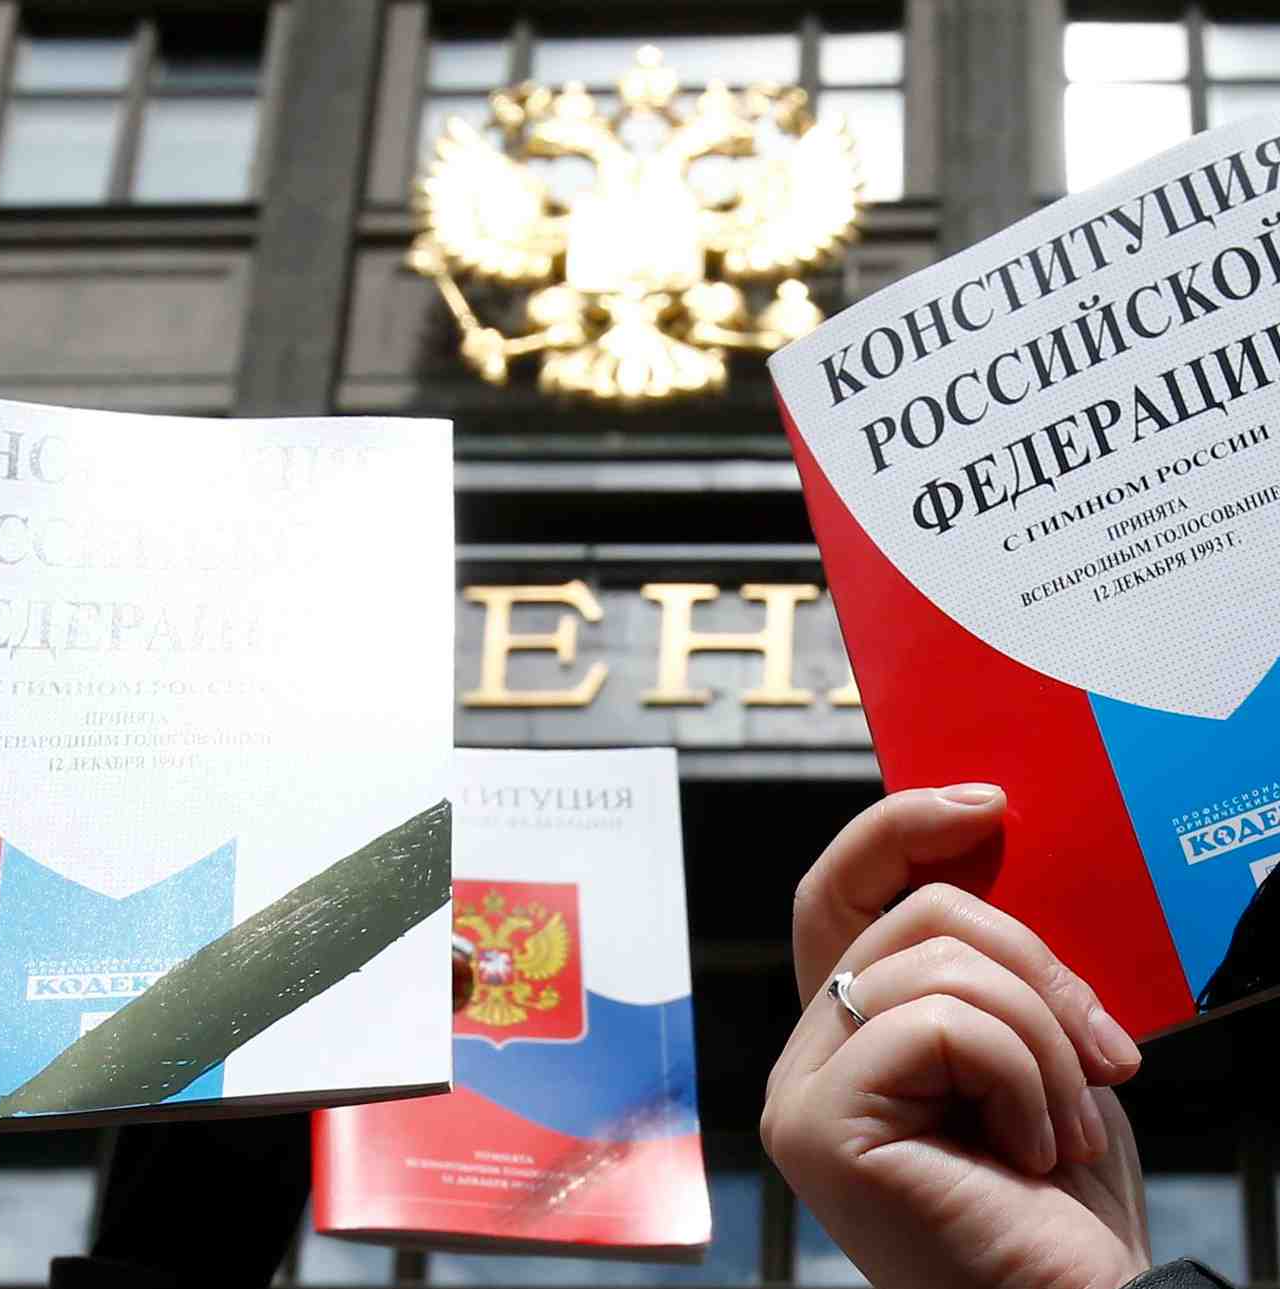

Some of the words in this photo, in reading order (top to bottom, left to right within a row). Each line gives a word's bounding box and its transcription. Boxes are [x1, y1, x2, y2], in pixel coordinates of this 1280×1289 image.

[1003, 534, 1020, 552] С
[1026, 476, 1150, 543] ГИМНОМ
[1157, 425, 1270, 485] РОССИИ
[1107, 498, 1188, 541] ПРИНЯТА
[1021, 539, 1152, 607] ВСЕНАРОДНЫМ
[1093, 585, 1111, 603] 12
[1113, 553, 1187, 598] ДЕКАБРЯ
[1191, 537, 1224, 563] 1993
